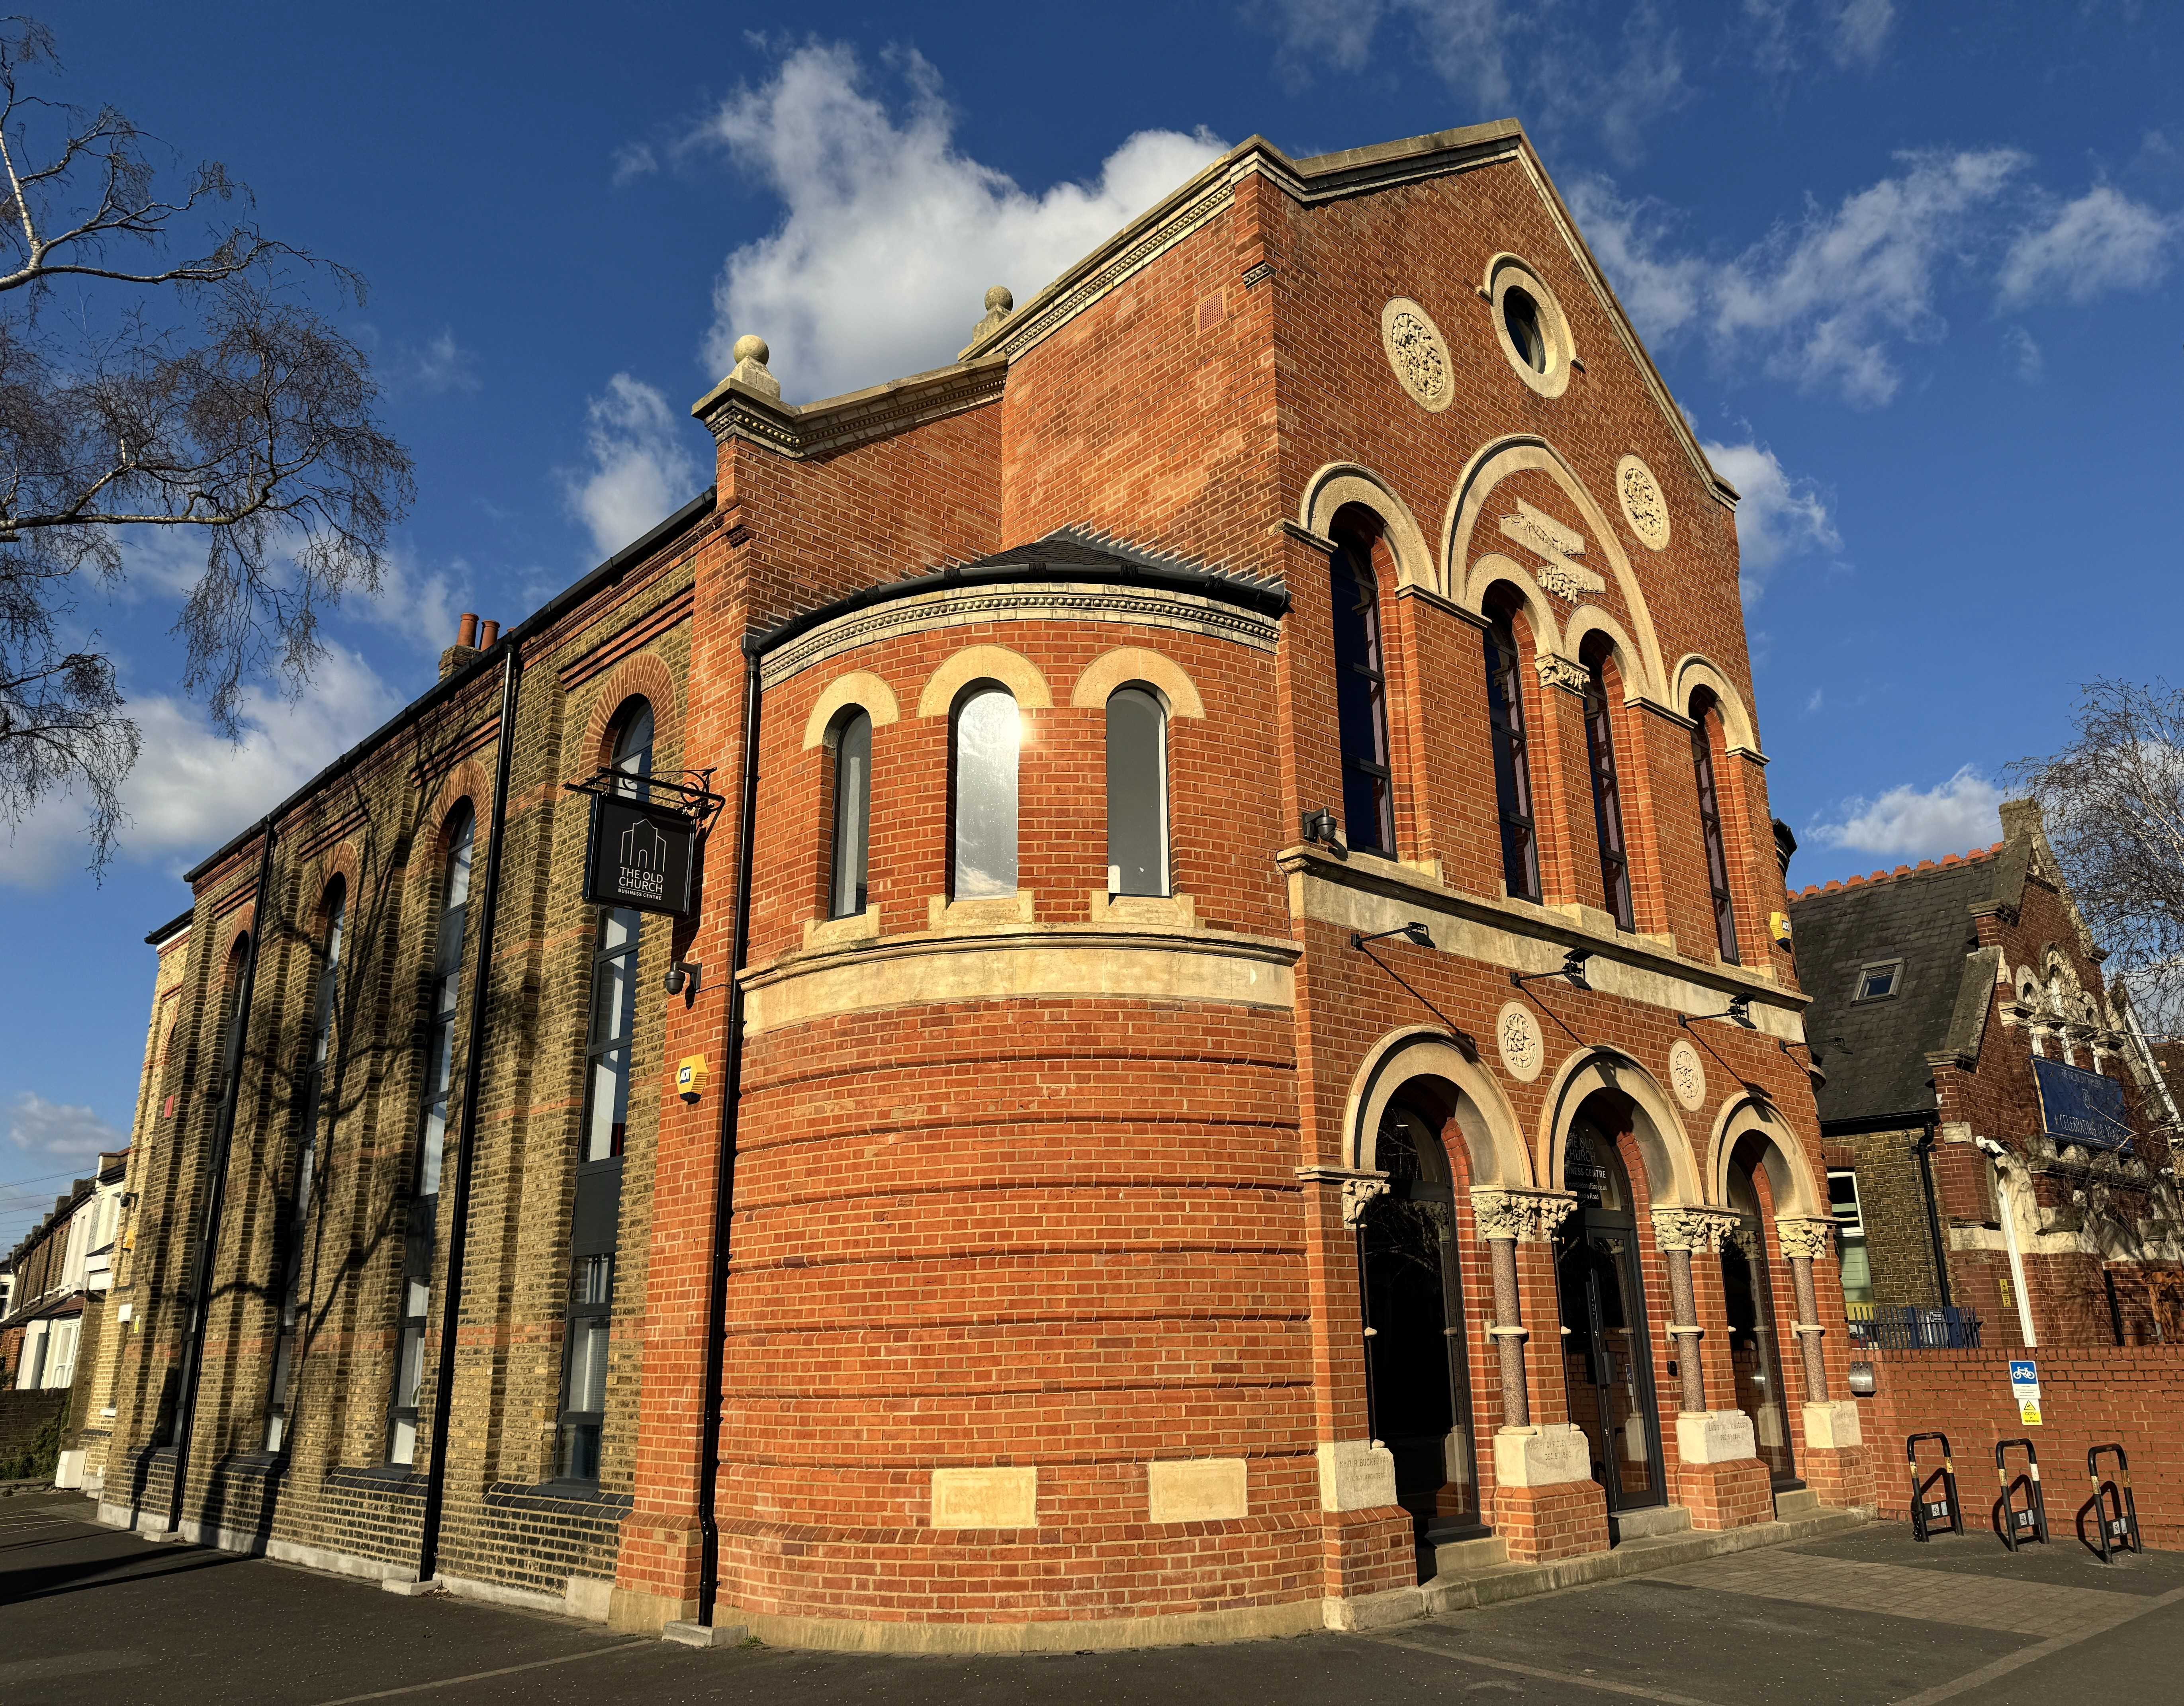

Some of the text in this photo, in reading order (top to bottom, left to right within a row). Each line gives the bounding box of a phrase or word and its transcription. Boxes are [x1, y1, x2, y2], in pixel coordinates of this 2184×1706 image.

[620, 867, 663, 883] THE OLD
[619, 876, 663, 893] CHURCH
[618, 888, 642, 896] BUSINESS
[679, 1068, 691, 1082] ADT
[1585, 1169, 1606, 1178] CENTRE
